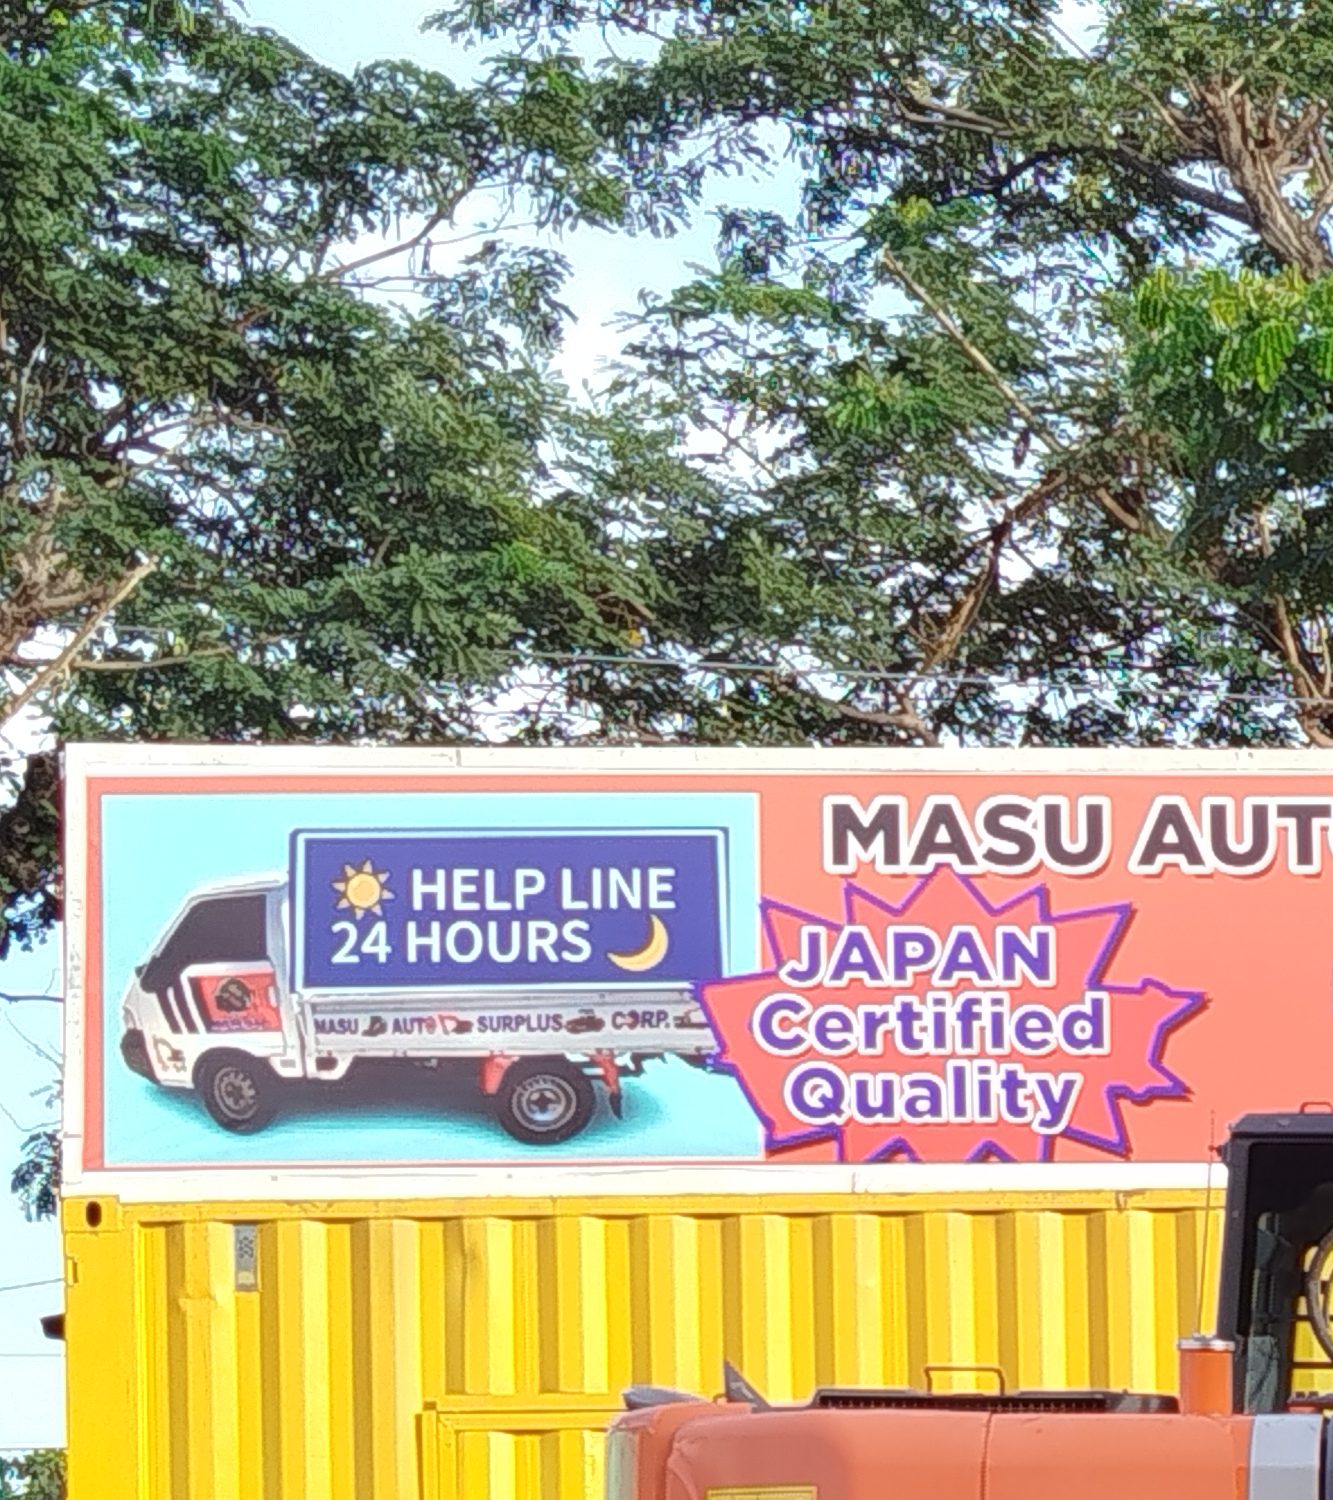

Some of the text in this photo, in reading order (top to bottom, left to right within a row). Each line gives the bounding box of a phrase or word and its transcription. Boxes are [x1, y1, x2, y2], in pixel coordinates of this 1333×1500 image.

[828, 799, 1108, 870] MASU
[411, 867, 678, 912] HELP LINE
[330, 919, 592, 965] 24 HOURS
[783, 928, 1053, 985] JAPAN
[391, 1016, 437, 1034] AUTO
[476, 1013, 565, 1033] SURPLUS
[611, 1011, 671, 1030] CORP.
[757, 994, 1107, 1053] Certified
[787, 1064, 1078, 1131] Quality
